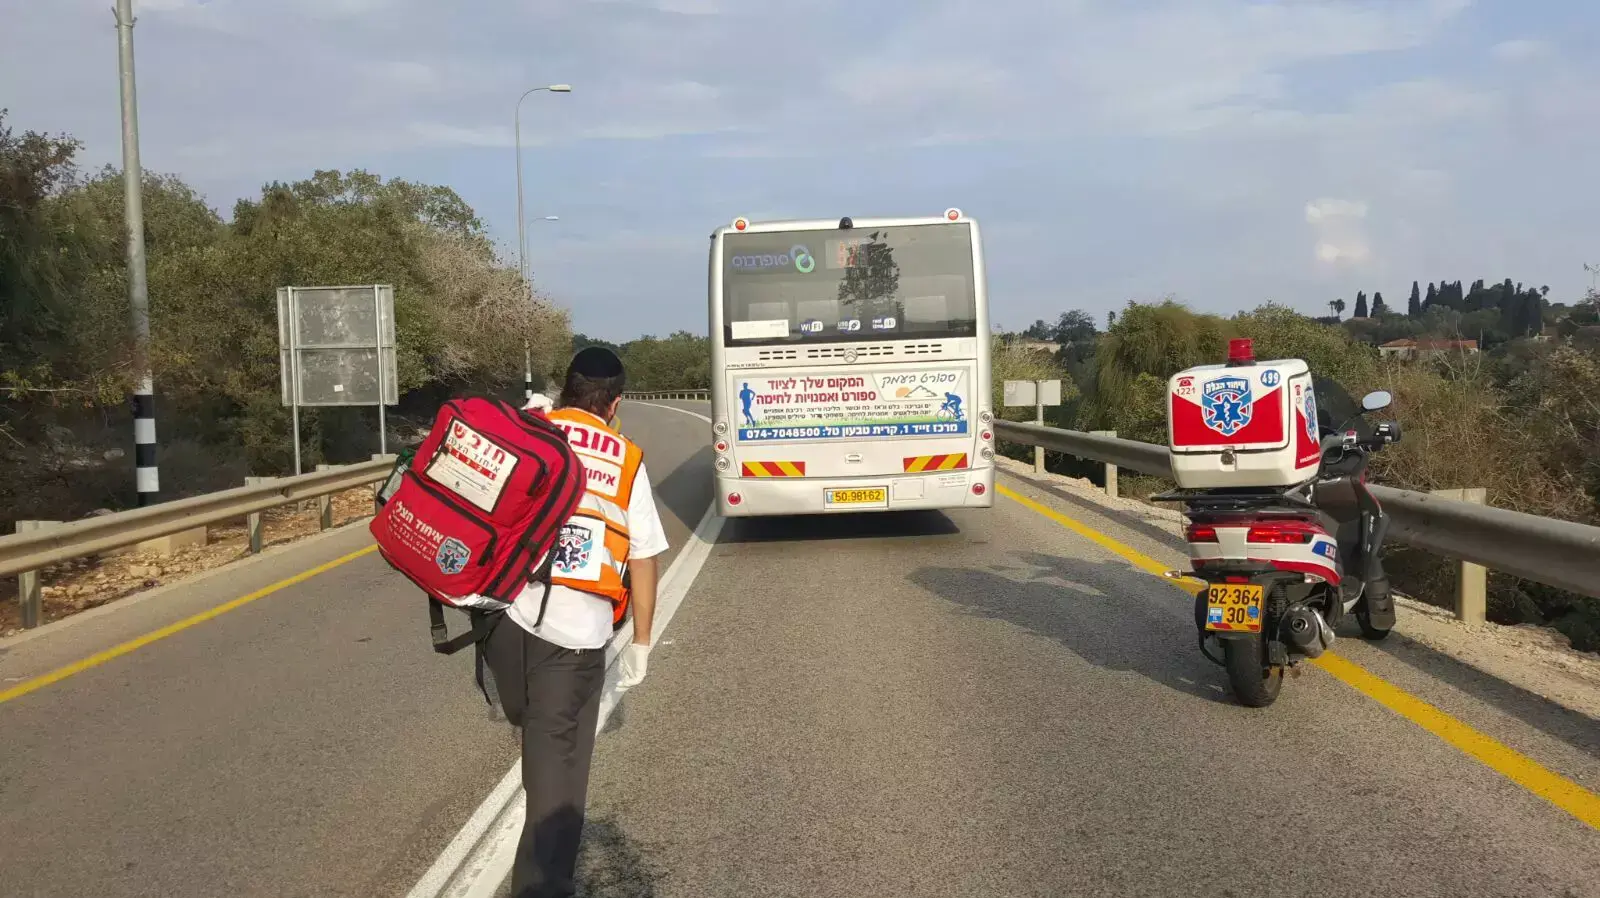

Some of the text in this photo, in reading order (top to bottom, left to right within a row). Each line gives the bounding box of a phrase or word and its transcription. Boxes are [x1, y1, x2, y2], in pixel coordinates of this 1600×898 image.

[767, 377, 864, 392] המקום שלך לציוד
[881, 373, 956, 388] ספורט בעמק
[1261, 371, 1279, 385] 499
[756, 391, 877, 405] ספורט ואמנויות לחימה
[1176, 387, 1196, 395] 1221
[746, 428, 820, 439] 074-7048500
[822, 426, 840, 436] טל:
[842, 426, 870, 437] טבעון
[872, 425, 898, 435] קרית
[933, 423, 958, 432] מרכז
[453, 423, 507, 465] חובש
[416, 519, 444, 544] איחוד
[1226, 607, 1245, 624] 30
